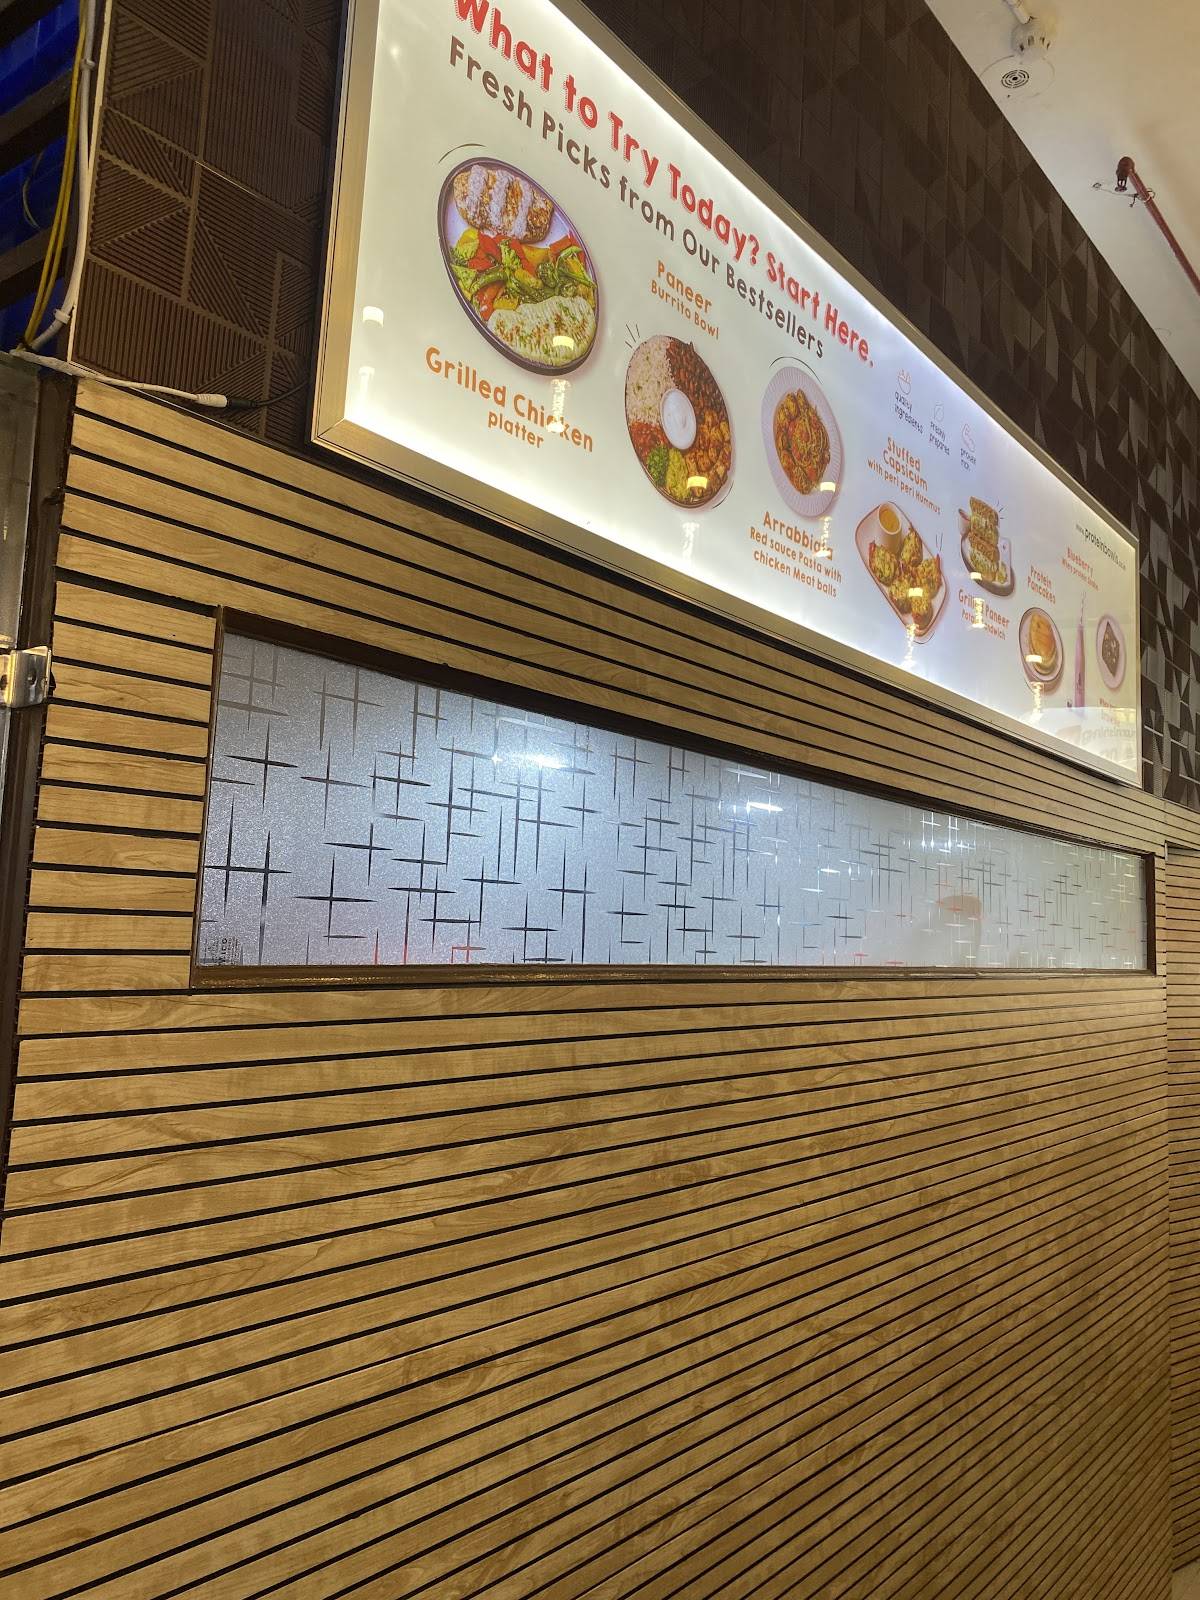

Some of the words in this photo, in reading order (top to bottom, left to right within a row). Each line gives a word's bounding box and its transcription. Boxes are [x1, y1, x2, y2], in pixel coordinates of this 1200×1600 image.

[450, 36, 532, 128] Fresh
[543, 111, 610, 188] Picks
[620, 176, 675, 241] from
[683, 229, 720, 274] Our
[727, 263, 823, 358] Bestsellers
[564, 74, 598, 129] to
[608, 111, 659, 188] Try
[668, 163, 760, 265] Today?
[766, 252, 820, 319] Start
[824, 303, 874, 367] Here.
[651, 280, 691, 319] Burrito
[694, 314, 719, 340] Bowl
[657, 260, 712, 313] Paneer
[425, 347, 507, 407] Grilled
[488, 411, 544, 448] platter
[887, 436, 921, 471] Stuffed
[868, 459, 883, 476] with
[884, 469, 899, 487] peri
[900, 480, 914, 497] peri
[883, 450, 928, 491] Capsicum
[750, 527, 768, 545] Red
[770, 539, 797, 560] sauce
[799, 552, 822, 573] Pasta
[824, 566, 842, 583] with
[754, 550, 791, 576] chicken
[793, 567, 815, 588] Meat
[817, 580, 837, 598] balls
[985, 603, 1009, 630] Paneer
